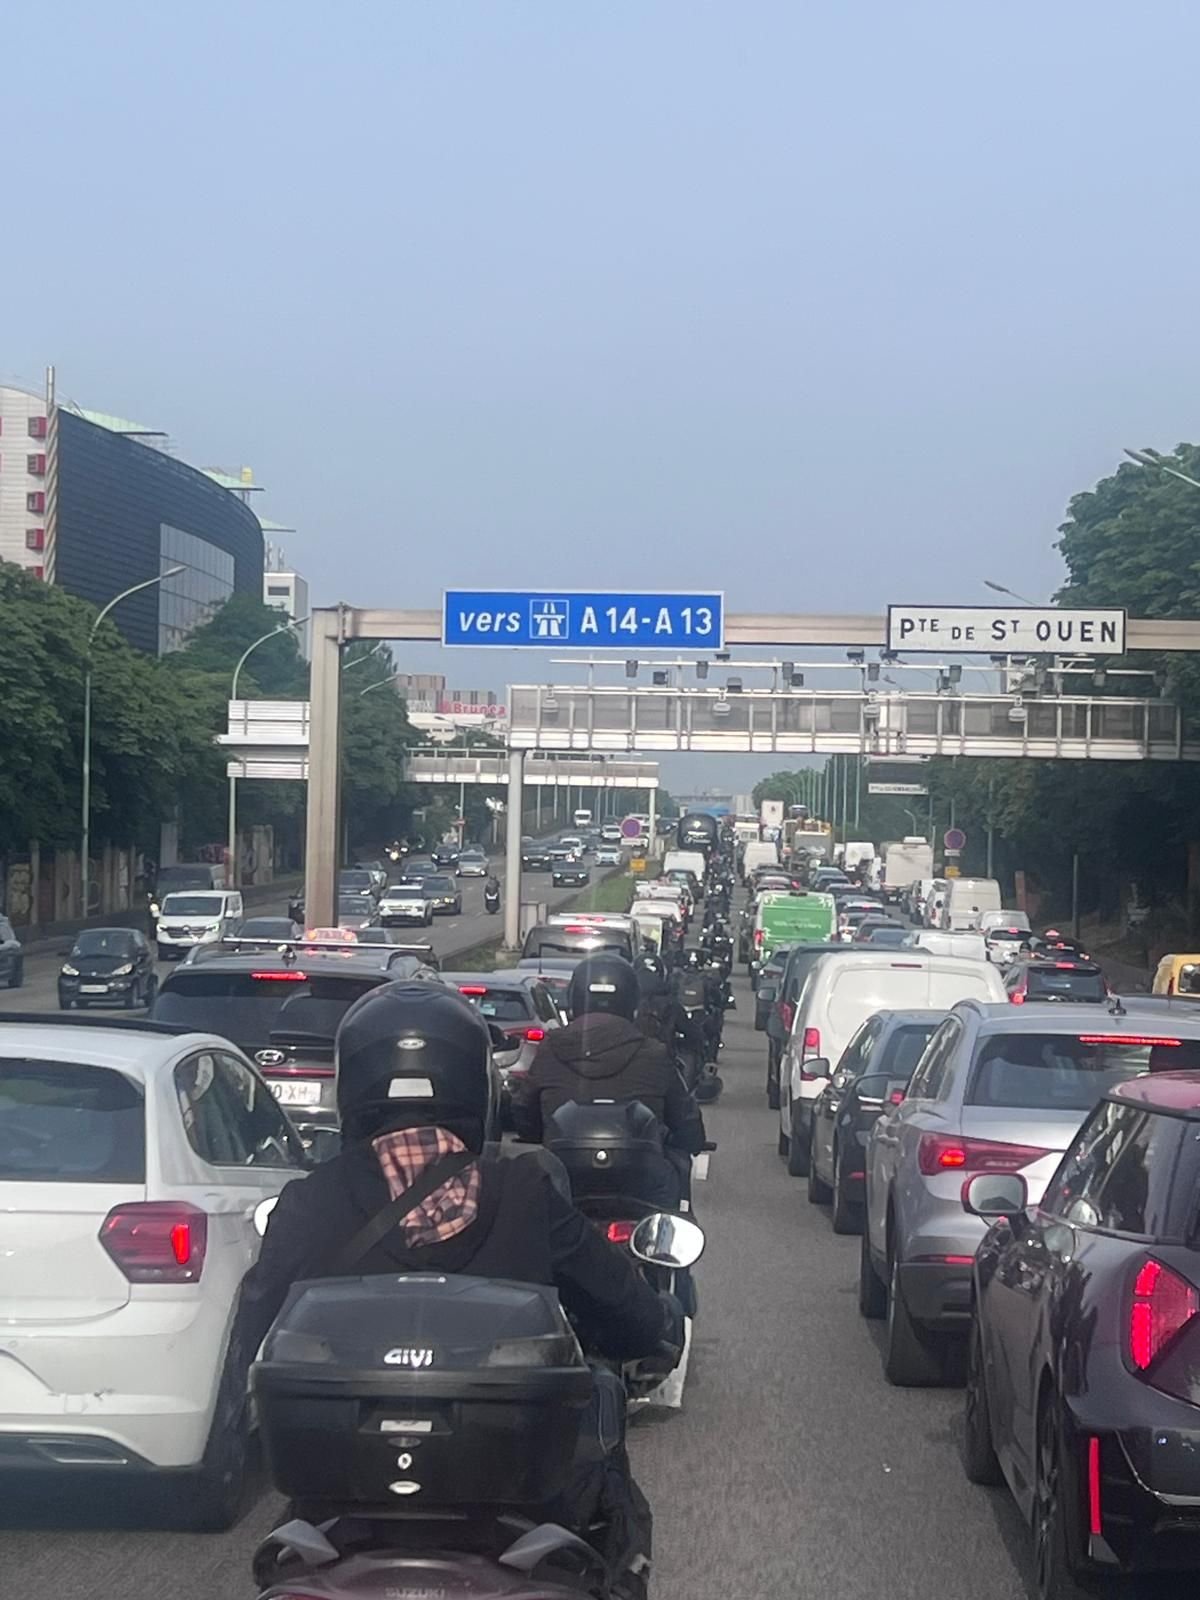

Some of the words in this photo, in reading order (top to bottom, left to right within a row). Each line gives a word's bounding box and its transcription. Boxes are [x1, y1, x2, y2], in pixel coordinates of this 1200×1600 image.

[459, 611, 521, 633] vers
[580, 606, 599, 634] A
[680, 607, 713, 636] 13
[951, 626, 975, 641] DE
[991, 619, 1020, 641] ST
[1035, 620, 1117, 643] OUEN
[383, 1347, 434, 1368] GIVI
